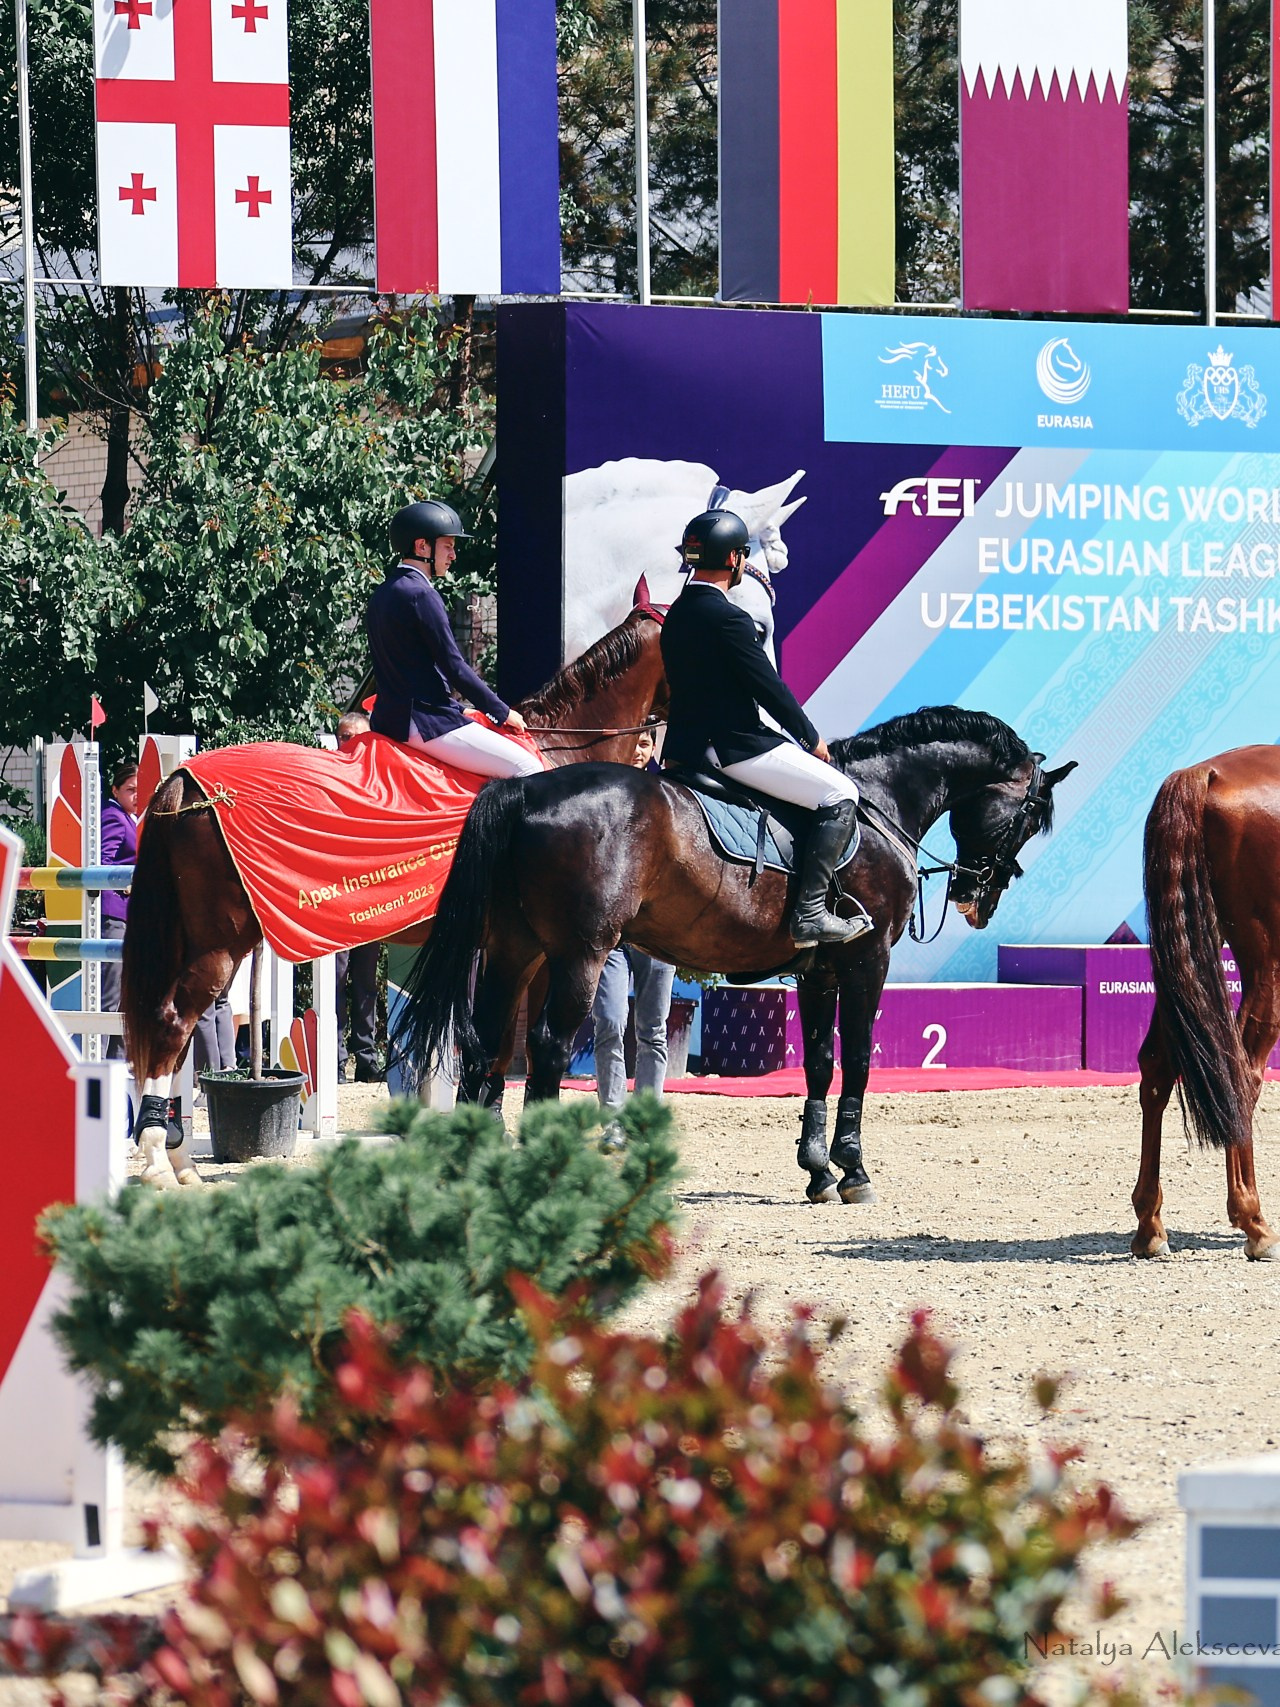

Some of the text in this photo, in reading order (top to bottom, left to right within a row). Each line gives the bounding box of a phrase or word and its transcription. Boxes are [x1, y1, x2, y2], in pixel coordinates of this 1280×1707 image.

[881, 384, 921, 399] HEFU
[1037, 414, 1094, 428] EURASIA
[879, 478, 975, 517] FEI
[995, 482, 1169, 522] JUMPING
[978, 537, 1169, 577] EURASIAN
[921, 592, 1160, 632] UZBEKISTAN
[298, 881, 342, 909] Apex
[342, 853, 427, 894] Insurance
[349, 882, 436, 925] Tashkent 2023
[1099, 981, 1156, 994] EURASIAN
[921, 1023, 948, 1069] 2
